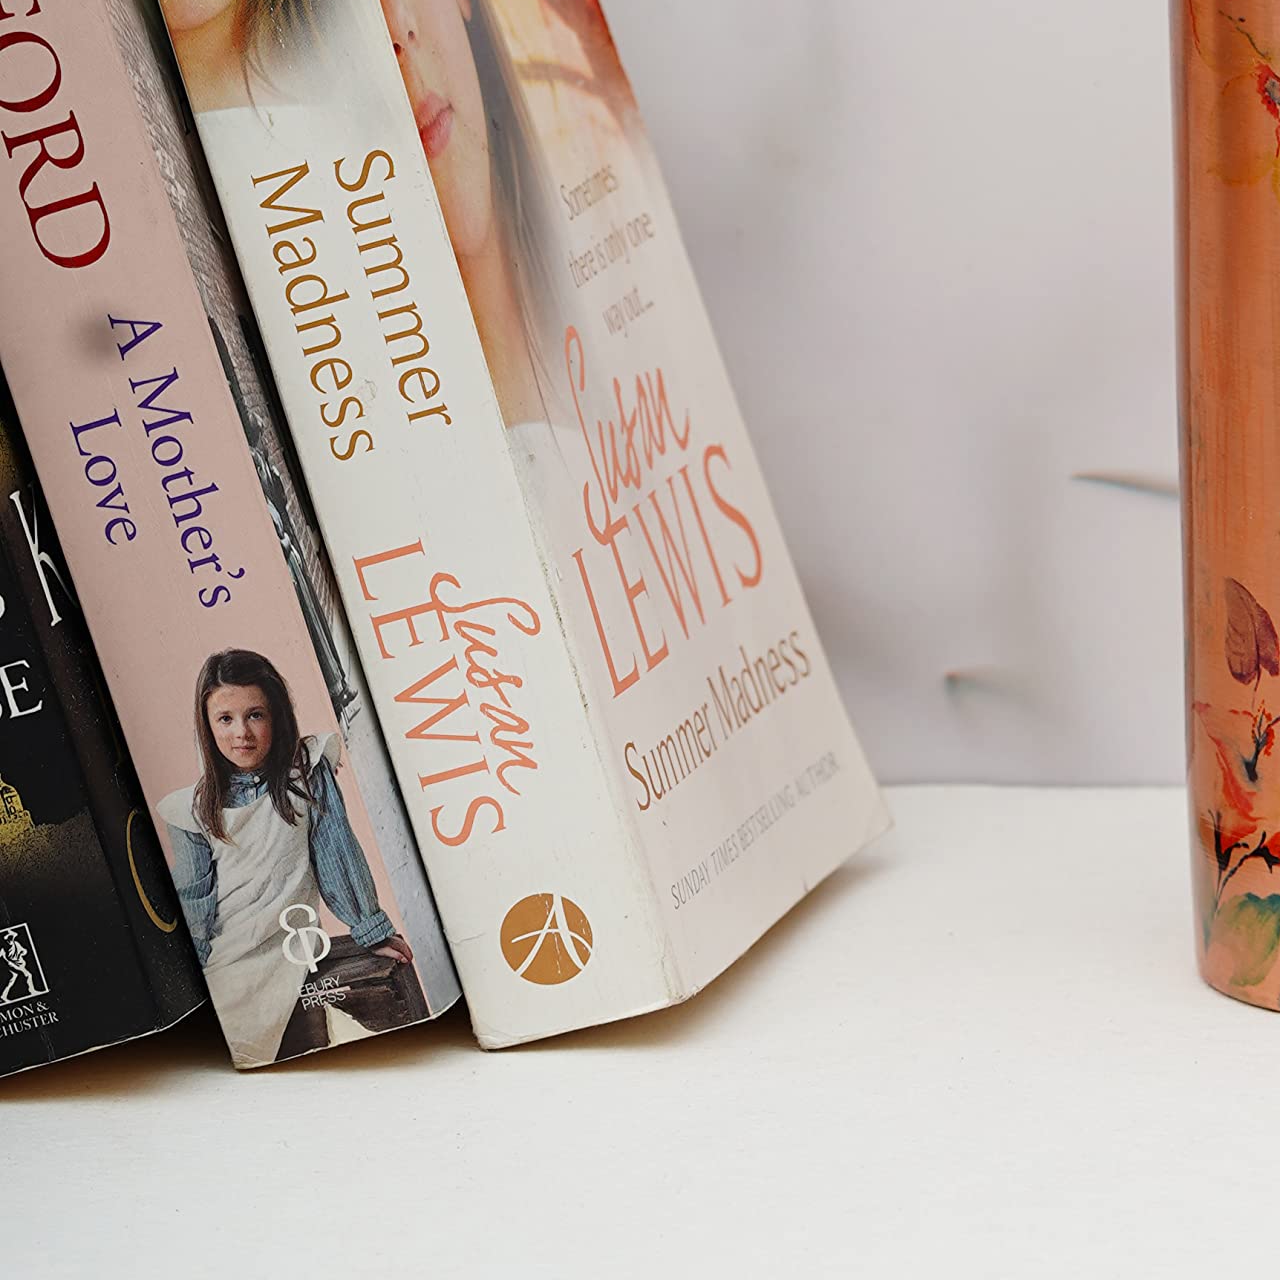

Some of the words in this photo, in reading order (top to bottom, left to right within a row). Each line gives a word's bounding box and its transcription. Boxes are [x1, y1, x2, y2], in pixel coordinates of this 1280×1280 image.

[251, 160, 376, 461] Madness
[333, 150, 452, 426] Summer
[568, 249, 598, 289] there
[625, 212, 654, 248] one
[602, 301, 628, 338] way
[107, 314, 163, 361] A
[69, 408, 137, 546] Love
[565, 325, 690, 546] Susan
[572, 442, 763, 699] LEWIS
[352, 537, 506, 846] LEWIS
[430, 572, 541, 796] Susan
[624, 703, 718, 811] Summer
[707, 630, 811, 741] Madness
[671, 861, 712, 910] SUNDAY
[710, 833, 740, 876] TIMES
[736, 784, 796, 852] BESTSELLING
[36, 1001, 50, 1013] &
[297, 975, 341, 998] EBURY
[301, 990, 347, 1011] PRESS
